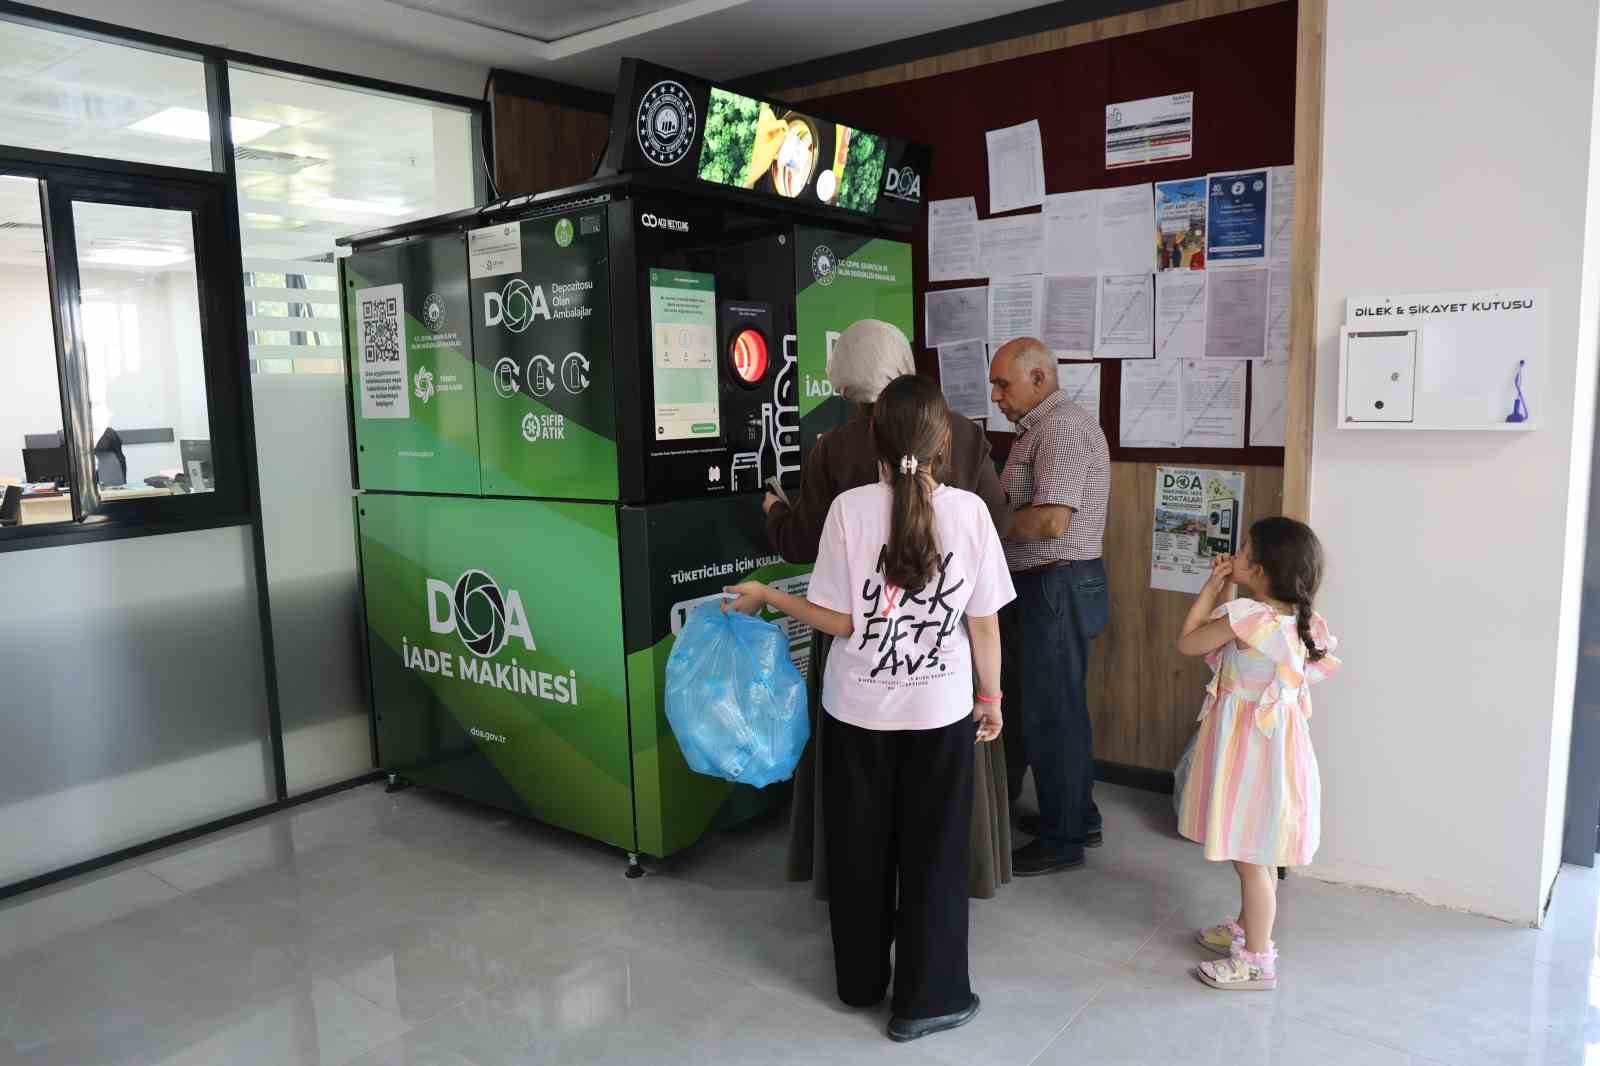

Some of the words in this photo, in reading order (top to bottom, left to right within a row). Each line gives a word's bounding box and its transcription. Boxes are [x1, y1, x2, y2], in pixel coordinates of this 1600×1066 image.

[885, 166, 920, 197] DOA
[551, 280, 593, 296] Depozitosu
[484, 278, 551, 333] DOA
[552, 296, 571, 307] Olan
[1355, 306, 1392, 317] DİLEK
[1471, 299, 1533, 312] KUTUSU
[553, 306, 592, 320] Ambalajlar
[540, 414, 564, 427] SIFIR
[541, 426, 565, 440] ATIK
[1163, 474, 1202, 490] DOA
[671, 562, 734, 584] TÜKETİCİLER
[735, 555, 754, 574] İÇİN
[426, 568, 537, 658] DOA
[402, 635, 454, 677] İADE
[458, 657, 578, 705] MAKİNESİ
[470, 727, 507, 744] doa.gov.tr
